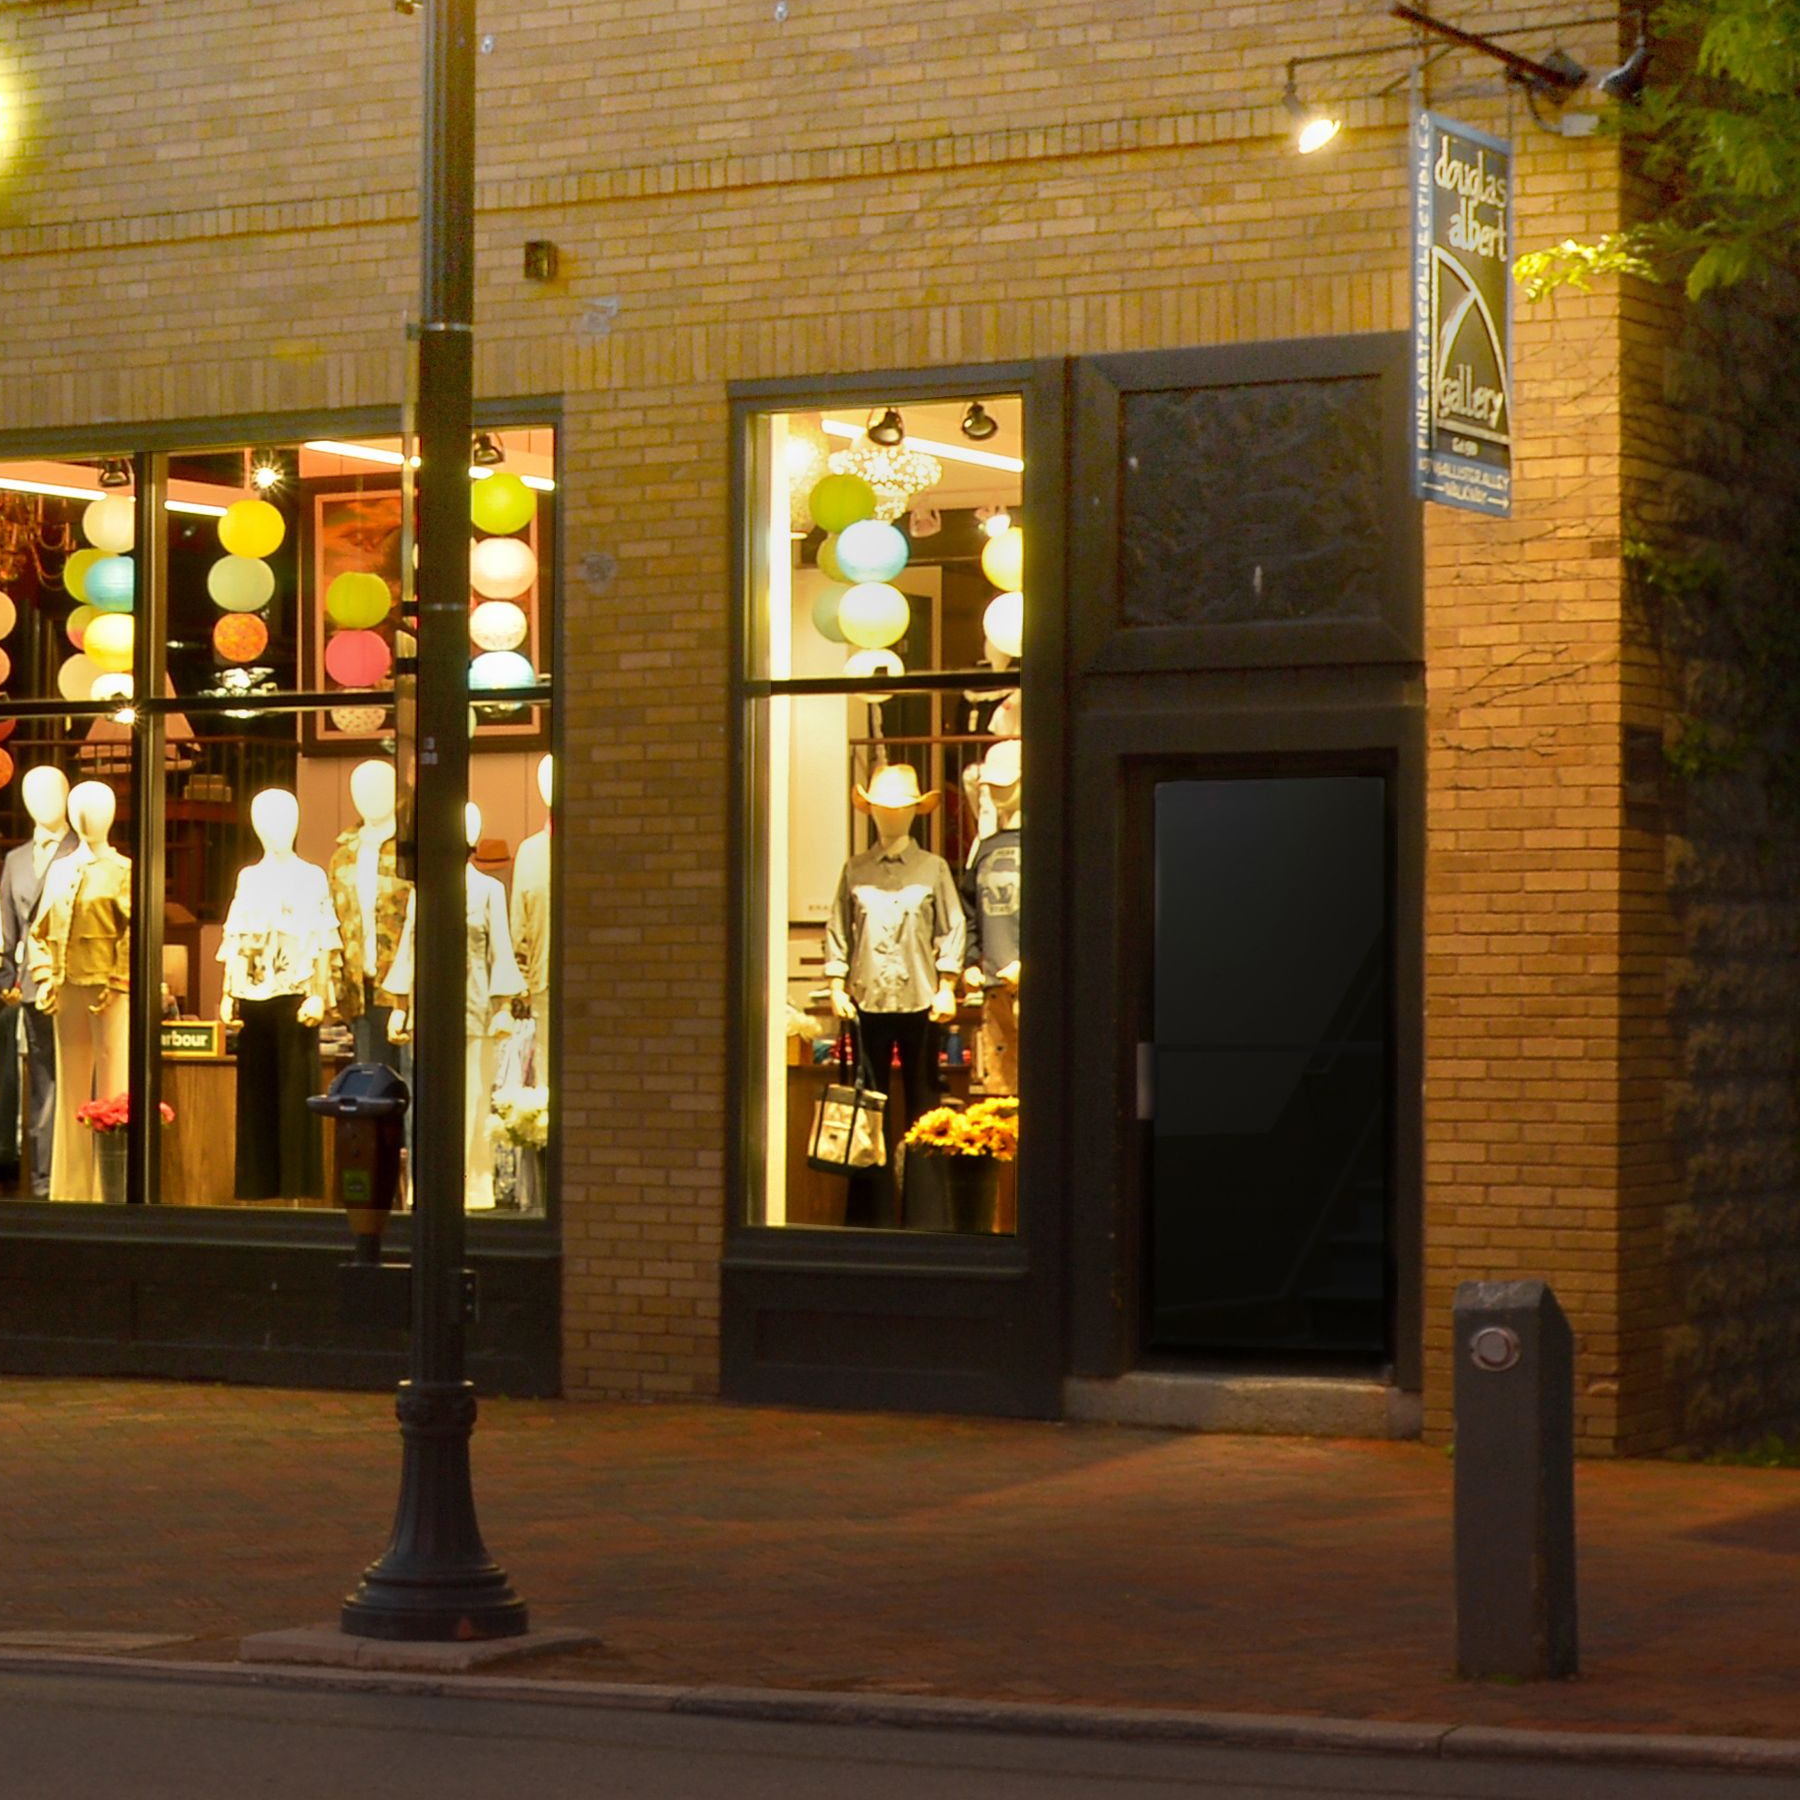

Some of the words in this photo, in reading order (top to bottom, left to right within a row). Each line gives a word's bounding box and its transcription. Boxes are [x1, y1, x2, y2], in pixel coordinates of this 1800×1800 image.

[1434, 135, 1508, 208] douglas
[1449, 197, 1508, 262] albert
[1416, 395, 1430, 449] FINE
[1439, 363, 1504, 429] gallery
[161, 1030, 209, 1048] rbour
